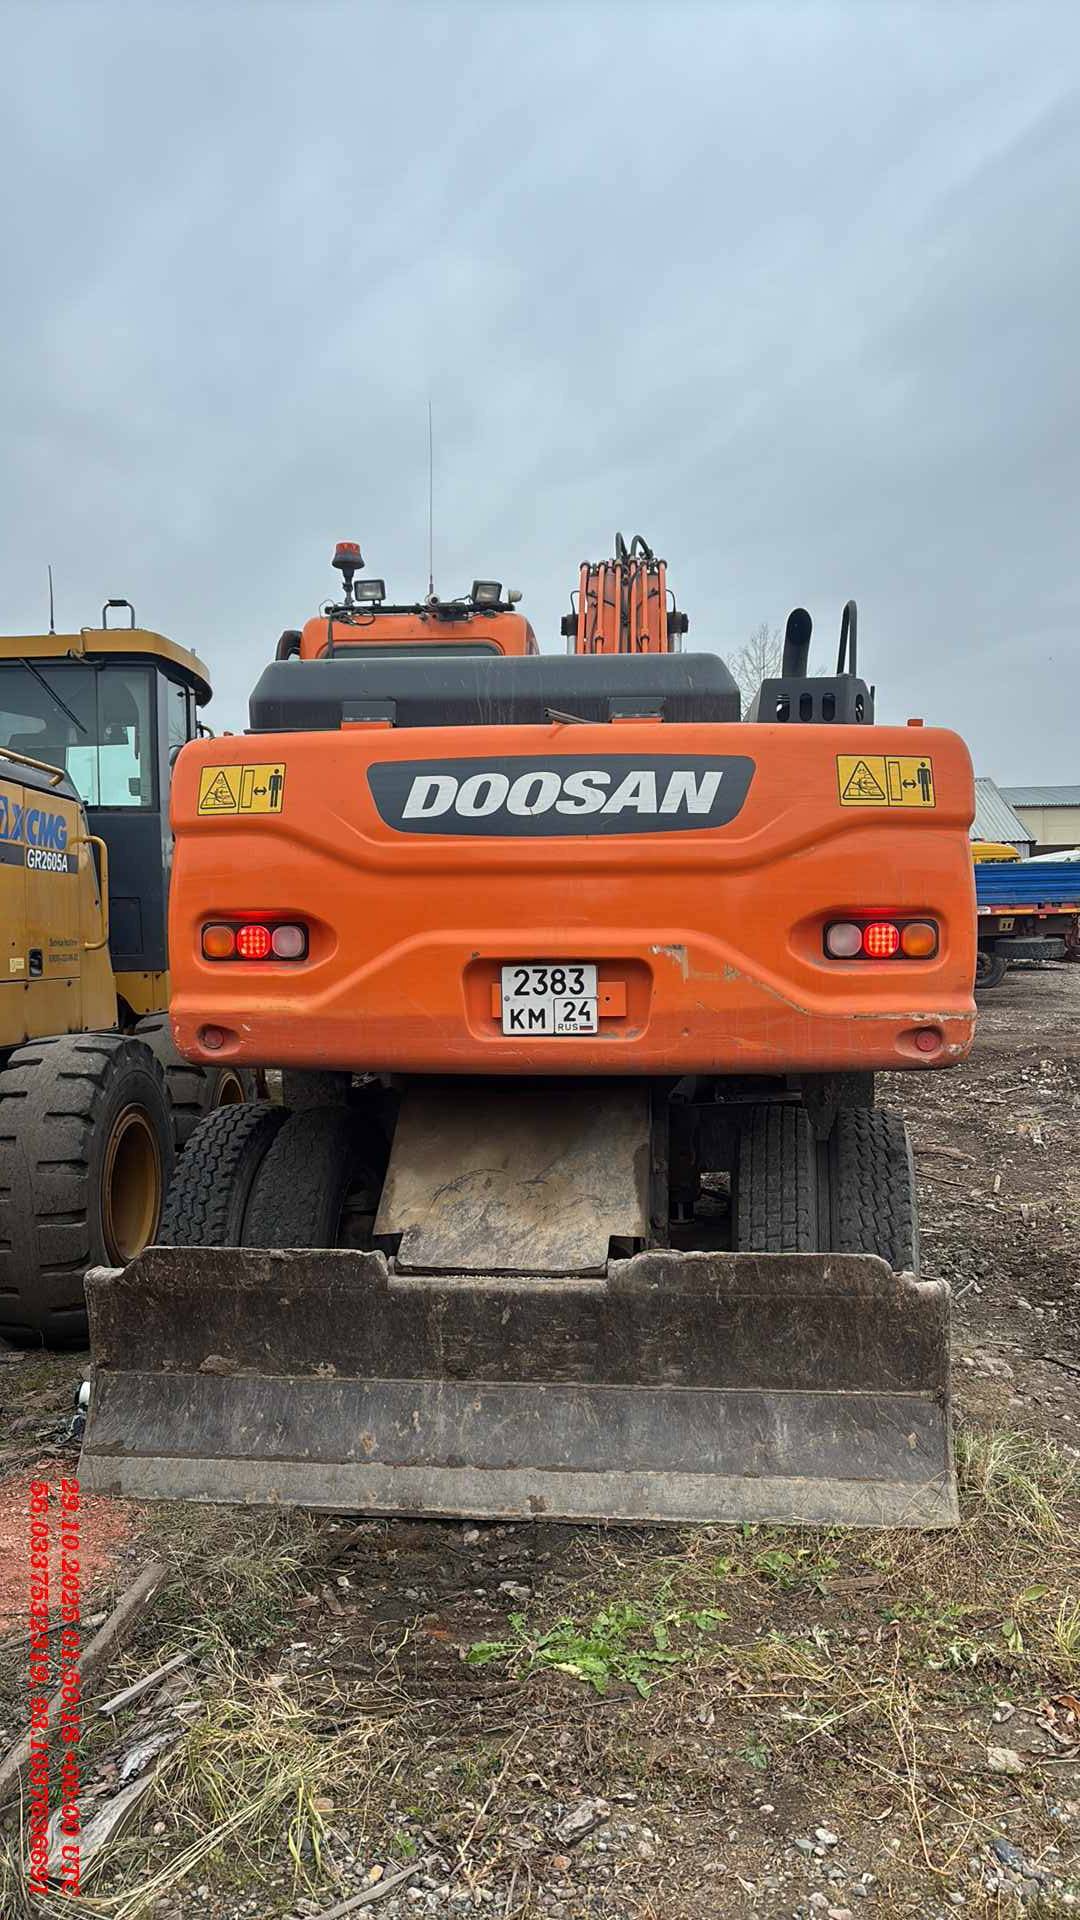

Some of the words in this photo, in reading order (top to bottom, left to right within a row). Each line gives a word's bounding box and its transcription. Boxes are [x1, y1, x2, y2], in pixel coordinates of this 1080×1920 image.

[401, 771, 724, 819] DOOSAN
[11, 803, 68, 850] XCMG
[27, 848, 68, 872] GR2605A
[513, 968, 585, 996] 2383
[510, 1008, 546, 1029] KM
[563, 1001, 591, 1022] 24
[557, 1023, 578, 1031] RUS
